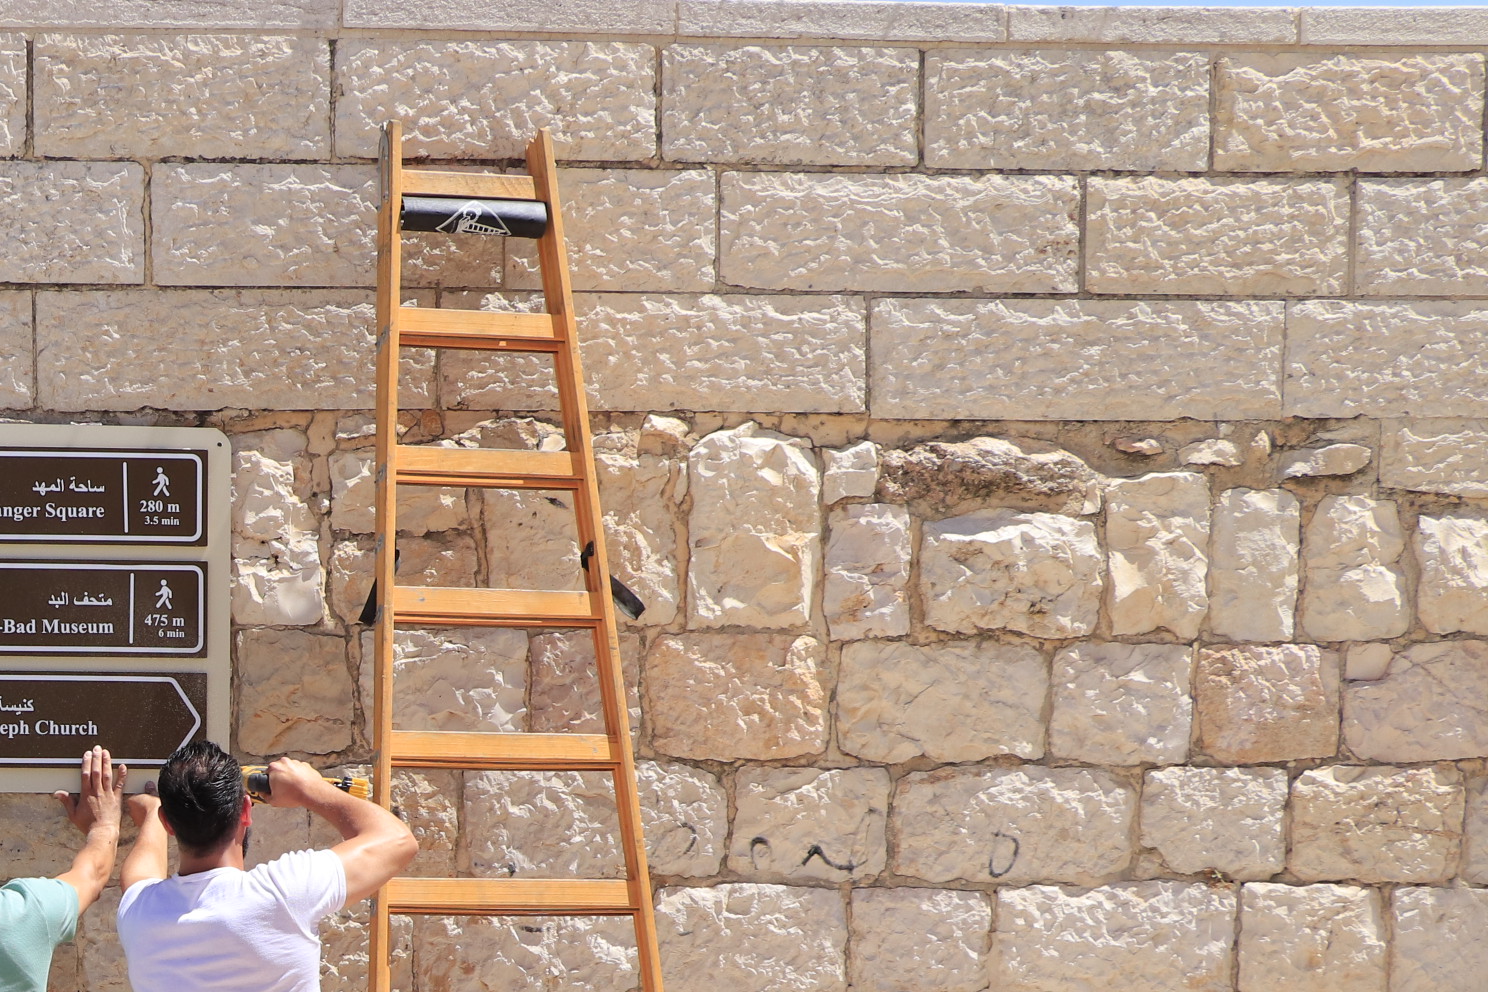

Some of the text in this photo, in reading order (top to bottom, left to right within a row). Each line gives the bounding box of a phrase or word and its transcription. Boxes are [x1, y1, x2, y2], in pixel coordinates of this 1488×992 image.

[32, 476, 105, 495] ساحة المهد
[45, 502, 105, 522] Square
[139, 499, 180, 513] 280 m
[144, 515, 180, 526] 3.5 min
[48, 591, 113, 609] متحف البد
[41, 618, 115, 634] Museum
[144, 613, 185, 627] 475 m
[158, 628, 185, 638] 6 min
[34, 719, 98, 736] Church
